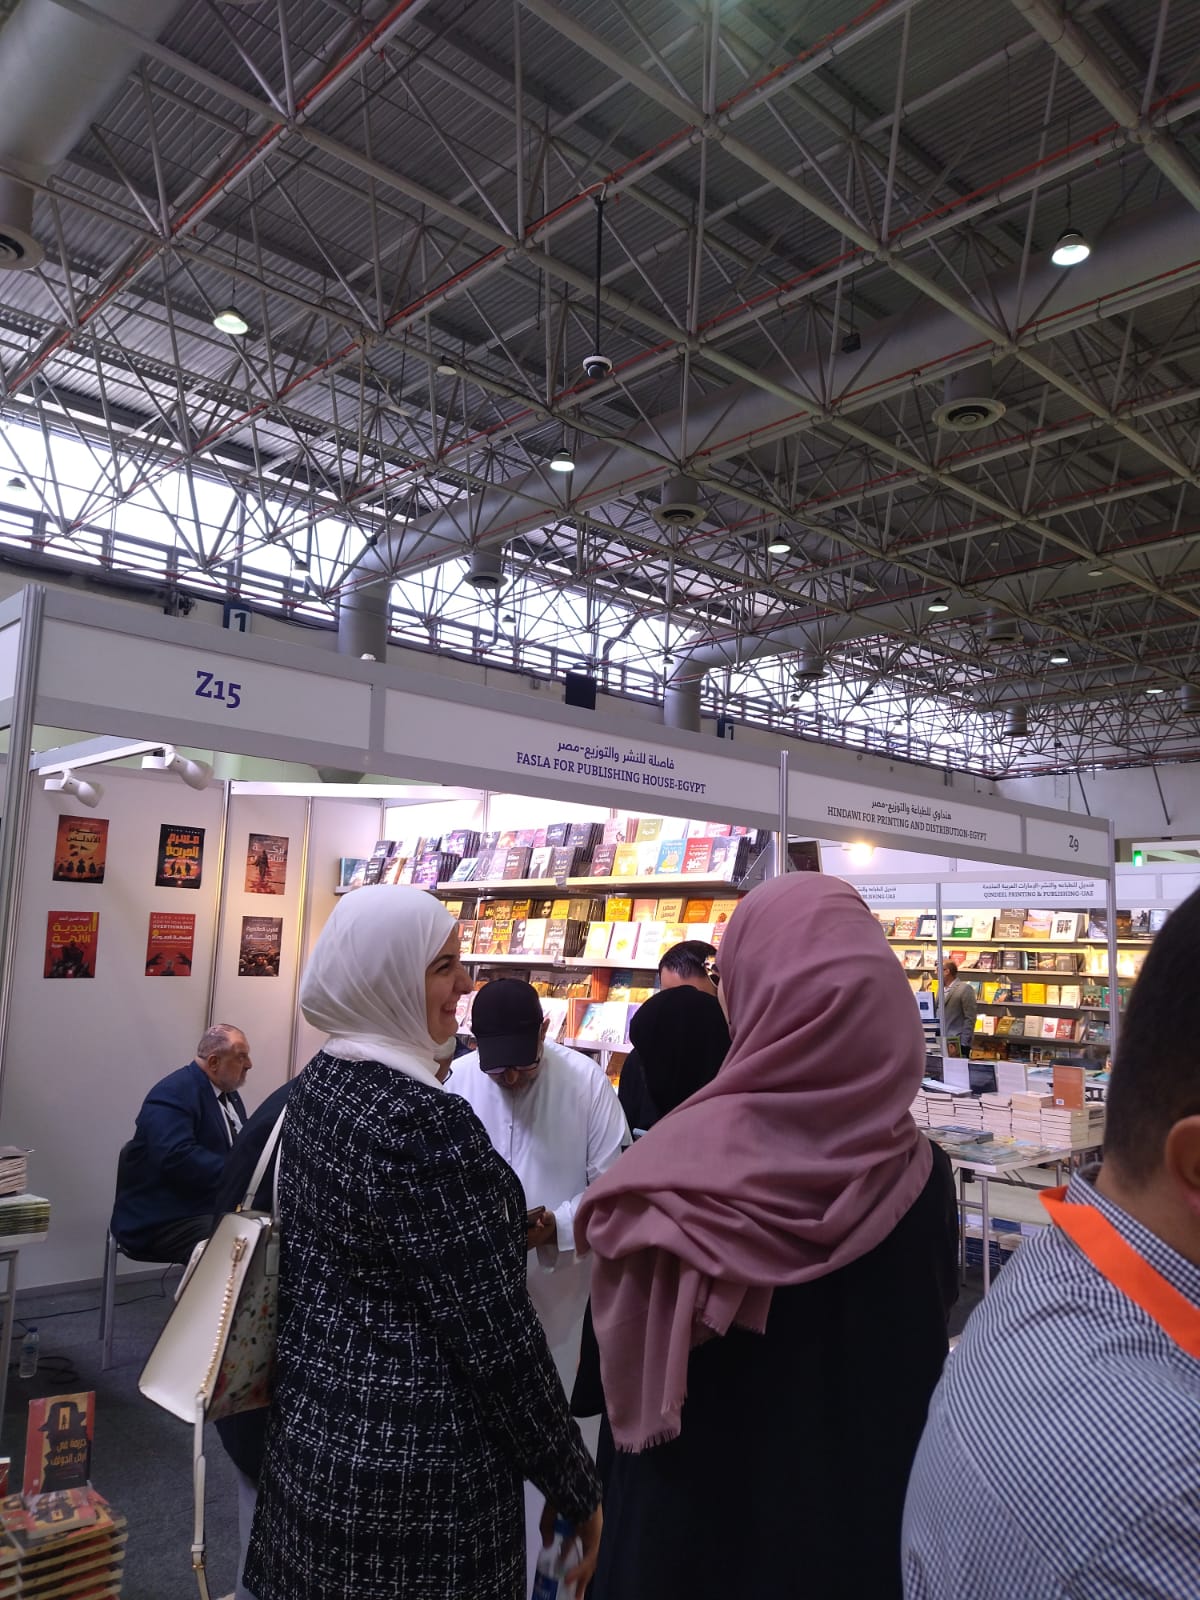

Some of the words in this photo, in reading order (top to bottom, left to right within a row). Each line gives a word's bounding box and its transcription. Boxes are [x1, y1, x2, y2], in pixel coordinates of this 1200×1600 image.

[195, 670, 241, 708] Z15
[557, 741, 620, 763] والتوزيع-مصر
[622, 749, 646, 764] للنشر
[648, 753, 675, 770] فاصلة
[516, 752, 551, 769] FASLA
[553, 758, 575, 773] FOR
[577, 762, 640, 784] PUBLISHING
[642, 774, 706, 794] HOUSE-EGYPT
[871, 799, 911, 815] والتوزيع-مصر
[911, 805, 932, 817] للطباعة
[932, 808, 952, 821] هنداوي
[827, 806, 861, 821] HINDAWI
[862, 812, 876, 823] FOR
[877, 814, 909, 829] PRINTING
[910, 819, 925, 831] AND
[925, 820, 987, 841] DISTRIBUTION-EGYPT
[1069, 834, 1079, 852] Z9
